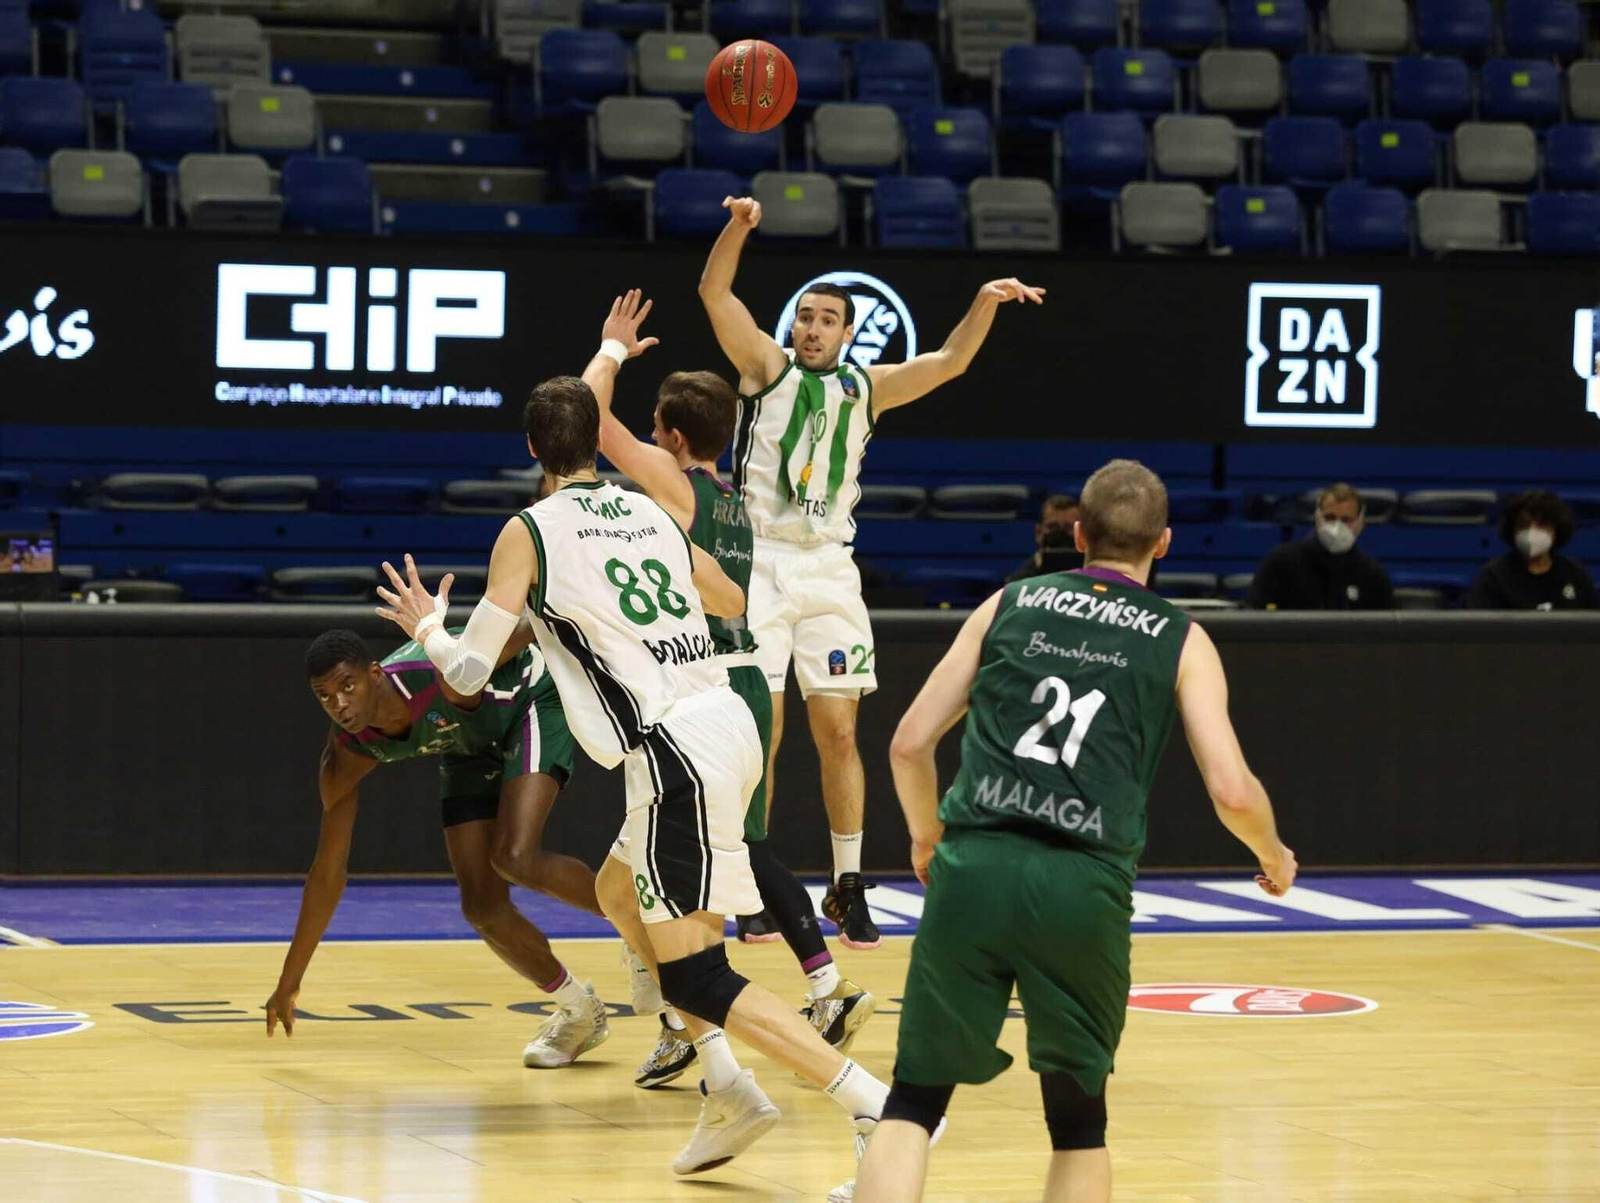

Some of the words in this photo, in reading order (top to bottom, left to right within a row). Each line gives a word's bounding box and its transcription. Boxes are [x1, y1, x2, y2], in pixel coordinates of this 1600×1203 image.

[849, 304, 898, 367] AYS
[604, 557, 691, 626] 88
[1016, 585, 1169, 638] WACZYŃSKI
[1013, 676, 1106, 769] 21
[974, 775, 1103, 839] MALAGA
